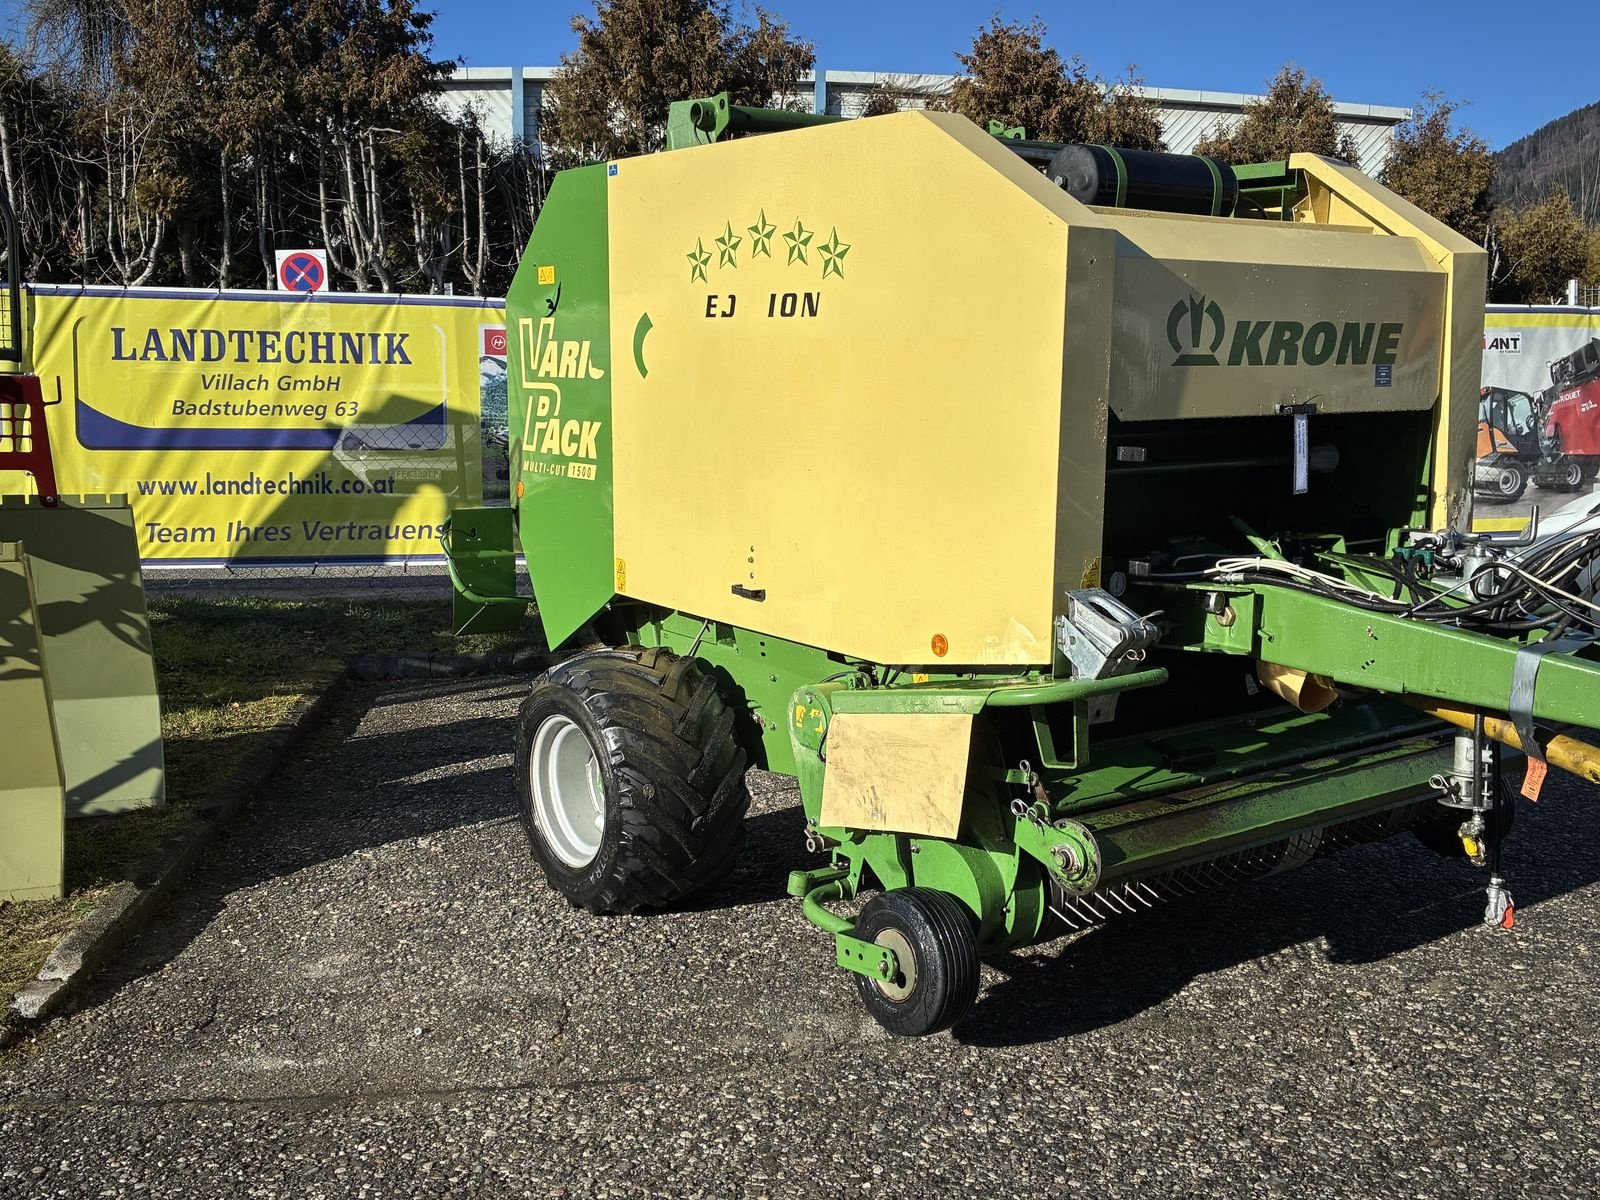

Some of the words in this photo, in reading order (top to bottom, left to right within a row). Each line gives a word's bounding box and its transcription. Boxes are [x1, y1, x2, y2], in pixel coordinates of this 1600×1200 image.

[111, 327, 413, 365] LANDTECHNIK
[1227, 320, 1404, 367] KRONE
[1483, 337, 1520, 350] ANT
[201, 373, 269, 392] Villach
[277, 375, 341, 392] GmbH
[172, 399, 328, 421] Badstubenweg
[335, 401, 359, 418] 63
[523, 381, 602, 460] PACK
[523, 460, 566, 476] MULTI-CUT
[572, 465, 592, 479] 1500
[137, 471, 396, 496] www.landtechnik.co.at
[145, 522, 216, 543] Team
[226, 520, 292, 543] Ihres
[302, 520, 444, 542] Vertrauens
